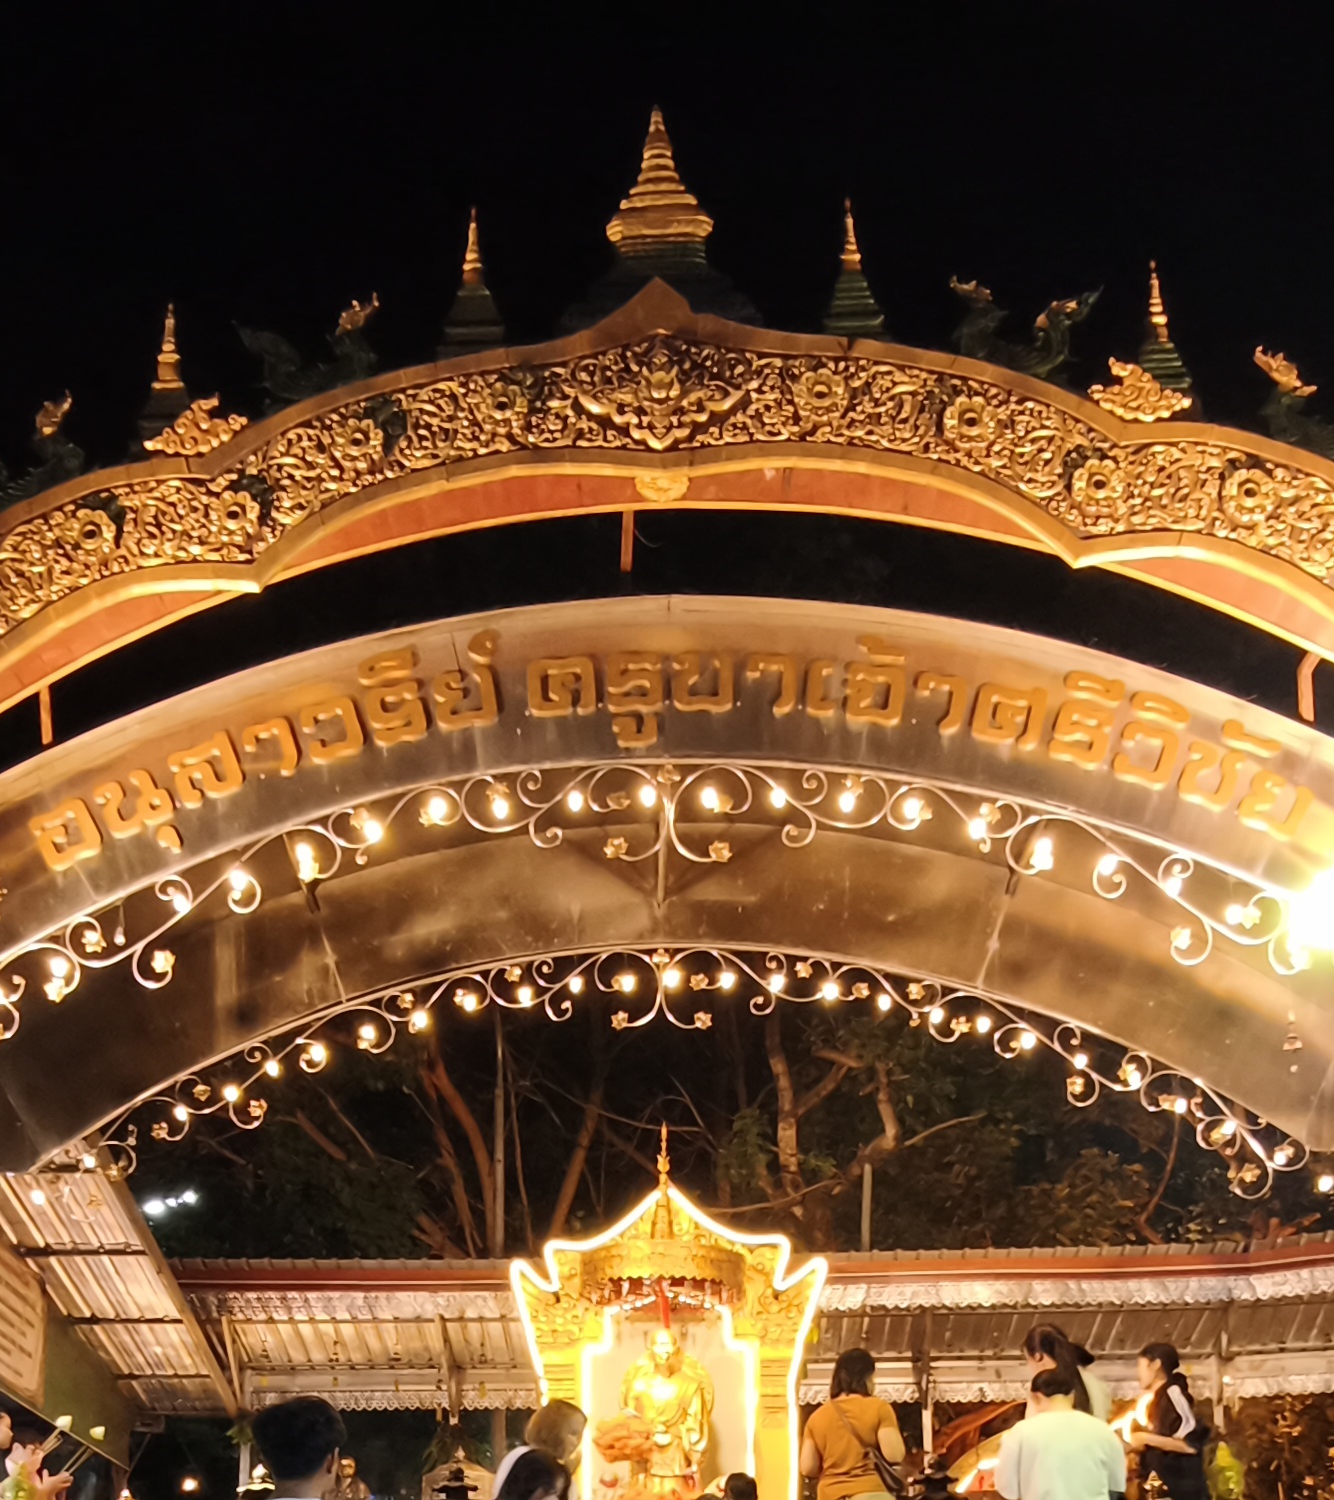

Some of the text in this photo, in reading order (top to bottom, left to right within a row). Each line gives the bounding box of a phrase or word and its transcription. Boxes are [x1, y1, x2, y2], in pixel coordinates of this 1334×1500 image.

[28, 629, 1312, 870] อนุสาวรีย์ ครูบาเจ้าศรีวิชัย
